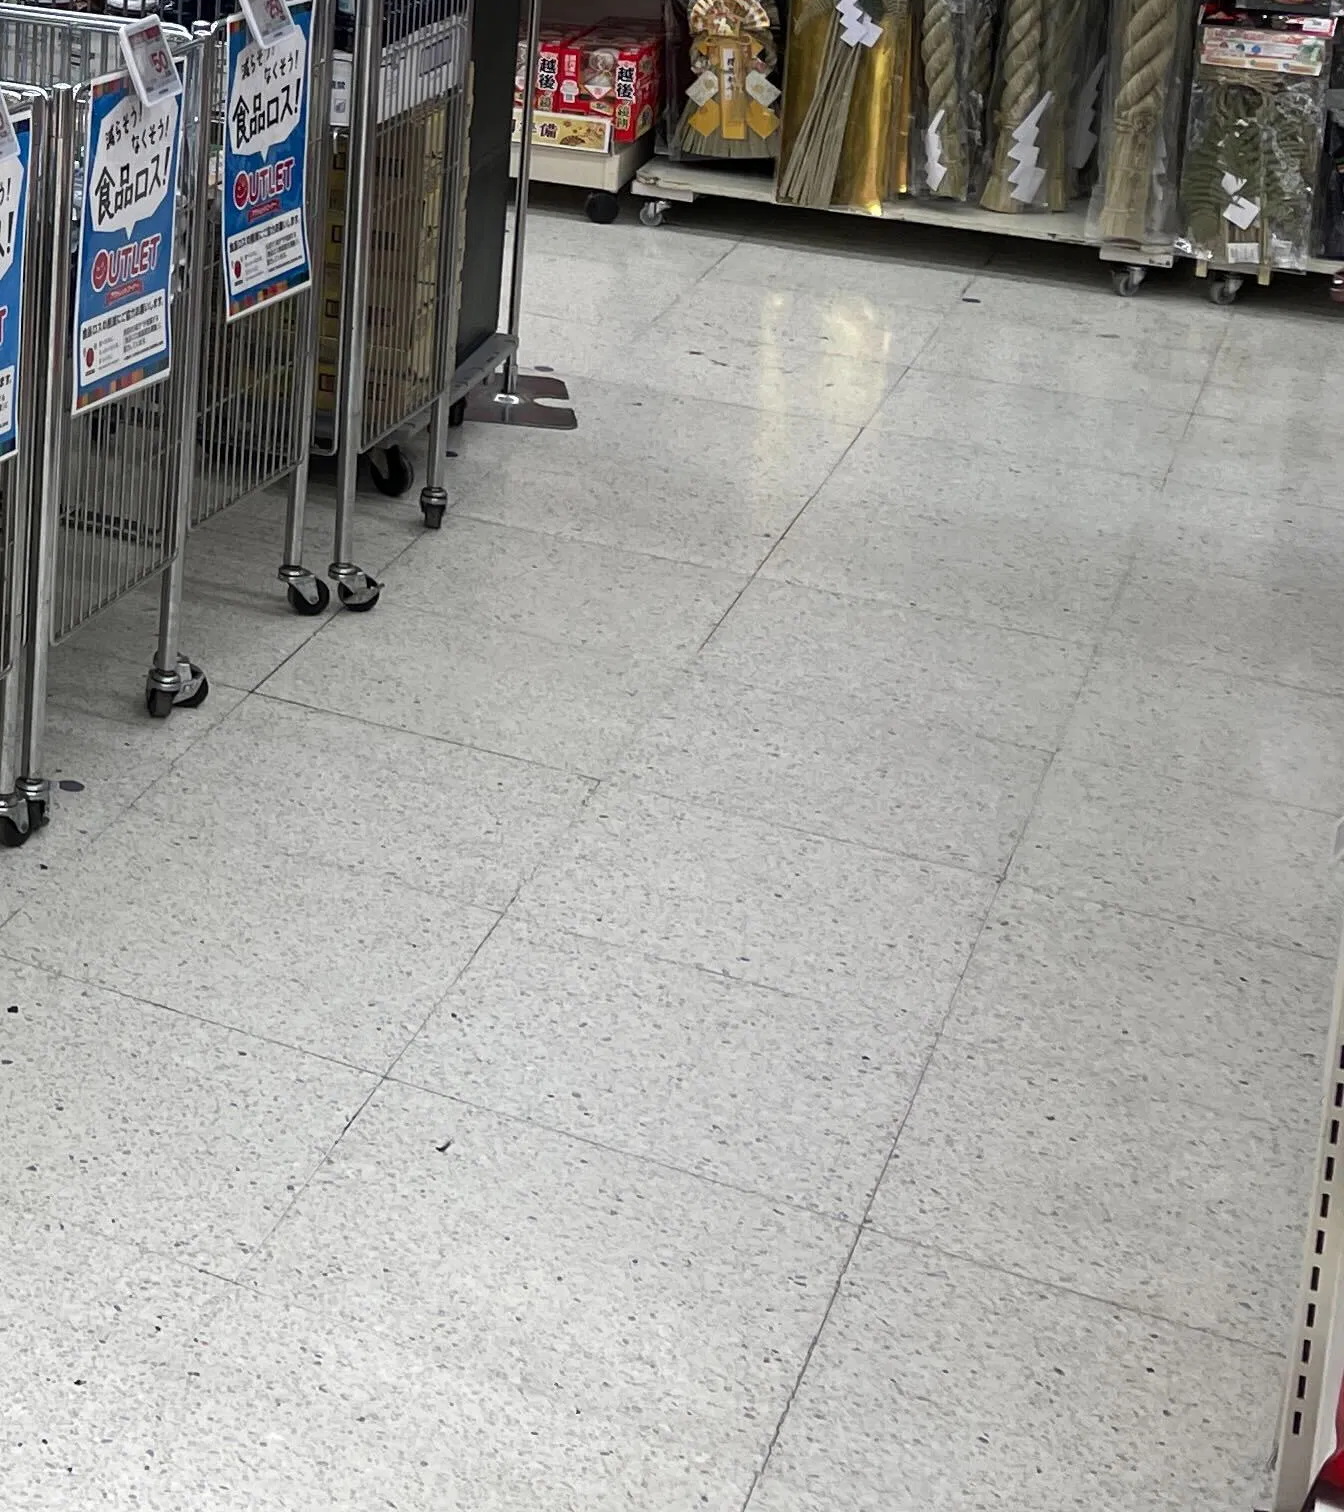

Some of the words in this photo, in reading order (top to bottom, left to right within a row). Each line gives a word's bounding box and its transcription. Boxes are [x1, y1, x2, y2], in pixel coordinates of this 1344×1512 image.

[263, 48, 300, 85] なくそう!
[538, 55, 559, 91] 越後
[615, 63, 637, 100] 越後
[130, 114, 171, 155] なくそう!
[232, 76, 302, 149] 食品ロス!
[94, 147, 172, 226] 食品ロス!
[232, 156, 296, 211] OUTLET
[90, 233, 163, 293] OUTLET
